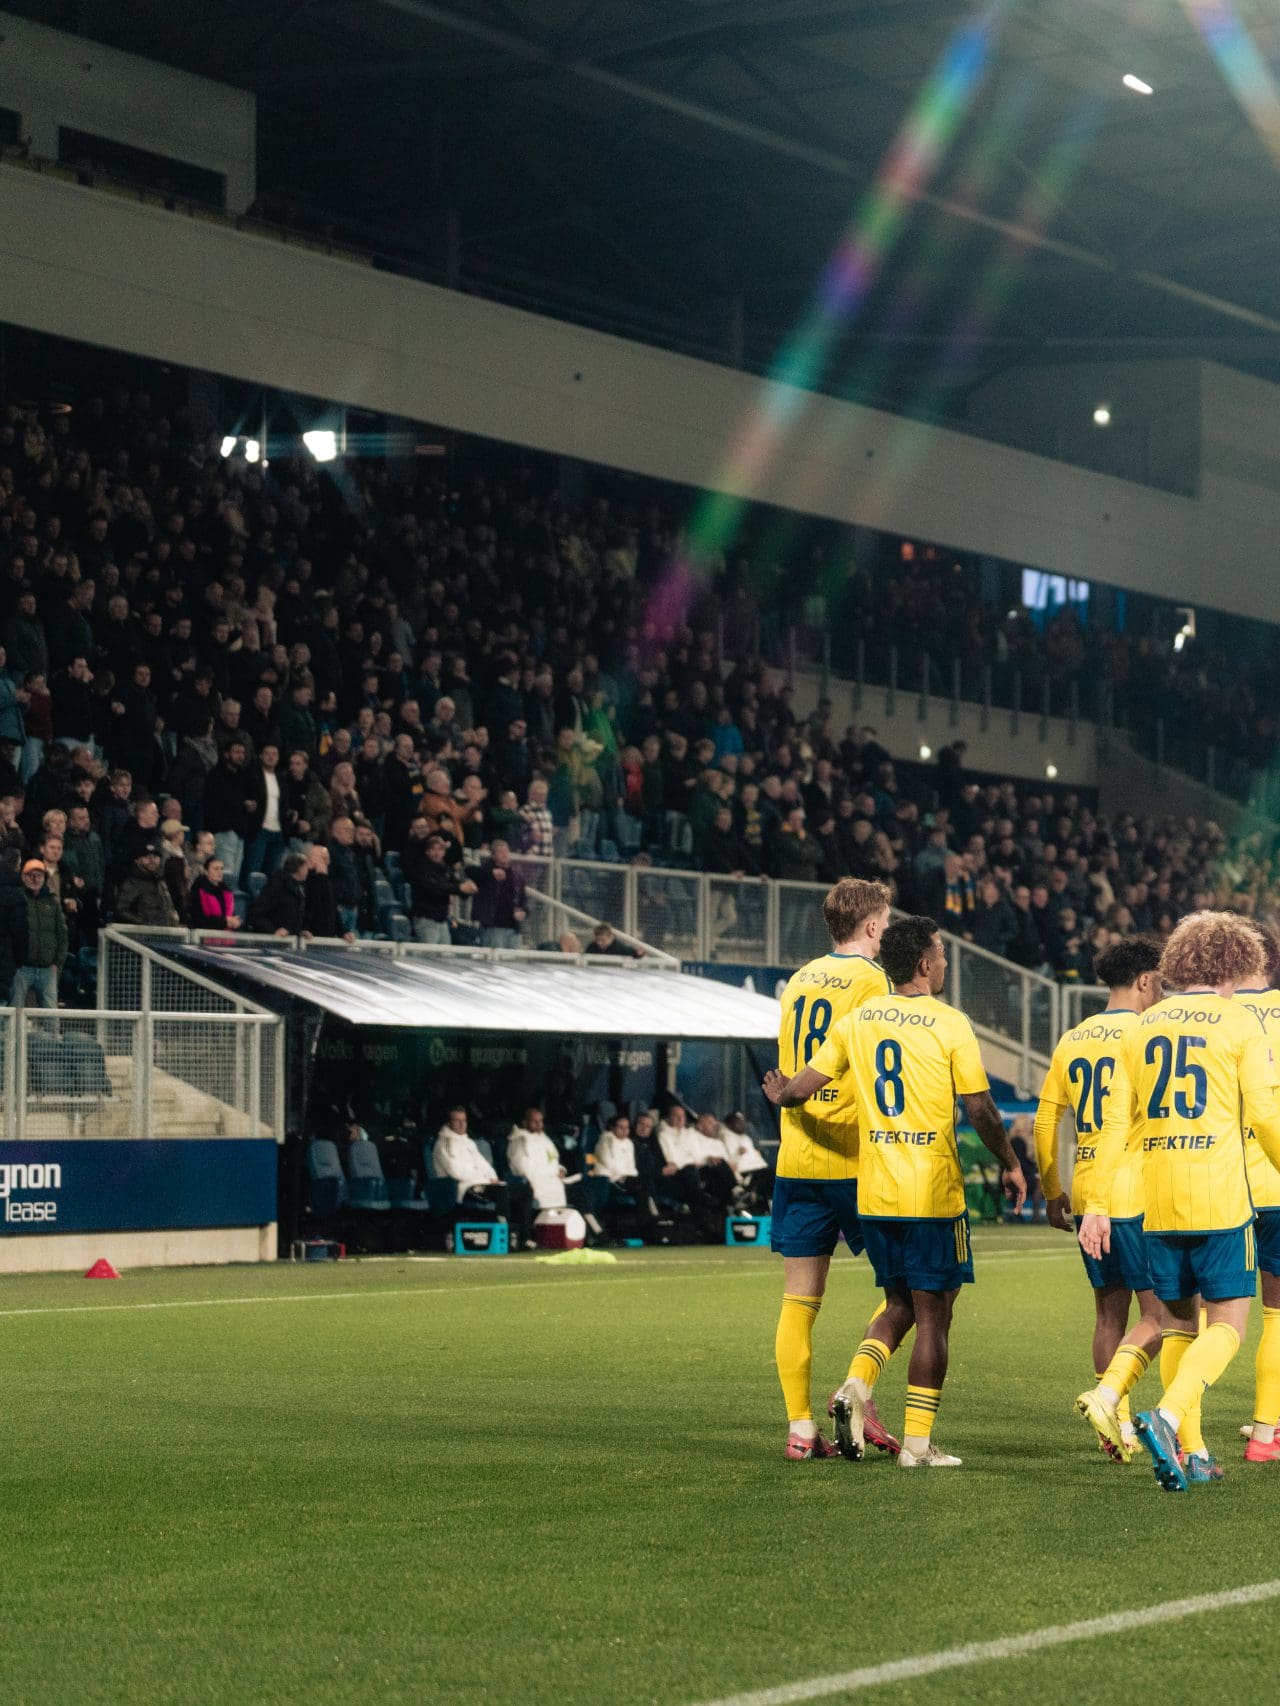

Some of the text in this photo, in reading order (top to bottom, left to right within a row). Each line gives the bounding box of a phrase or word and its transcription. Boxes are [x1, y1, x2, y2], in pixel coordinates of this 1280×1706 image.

[793, 995, 832, 1072] 18
[1068, 1025, 1123, 1042] tanQyo
[874, 1038, 905, 1117] 8
[1068, 1056, 1116, 1133] 26
[1145, 1035, 1208, 1119] 25
[869, 1130, 938, 1146] EFEKTIEF
[5, 1197, 57, 1222] lease
